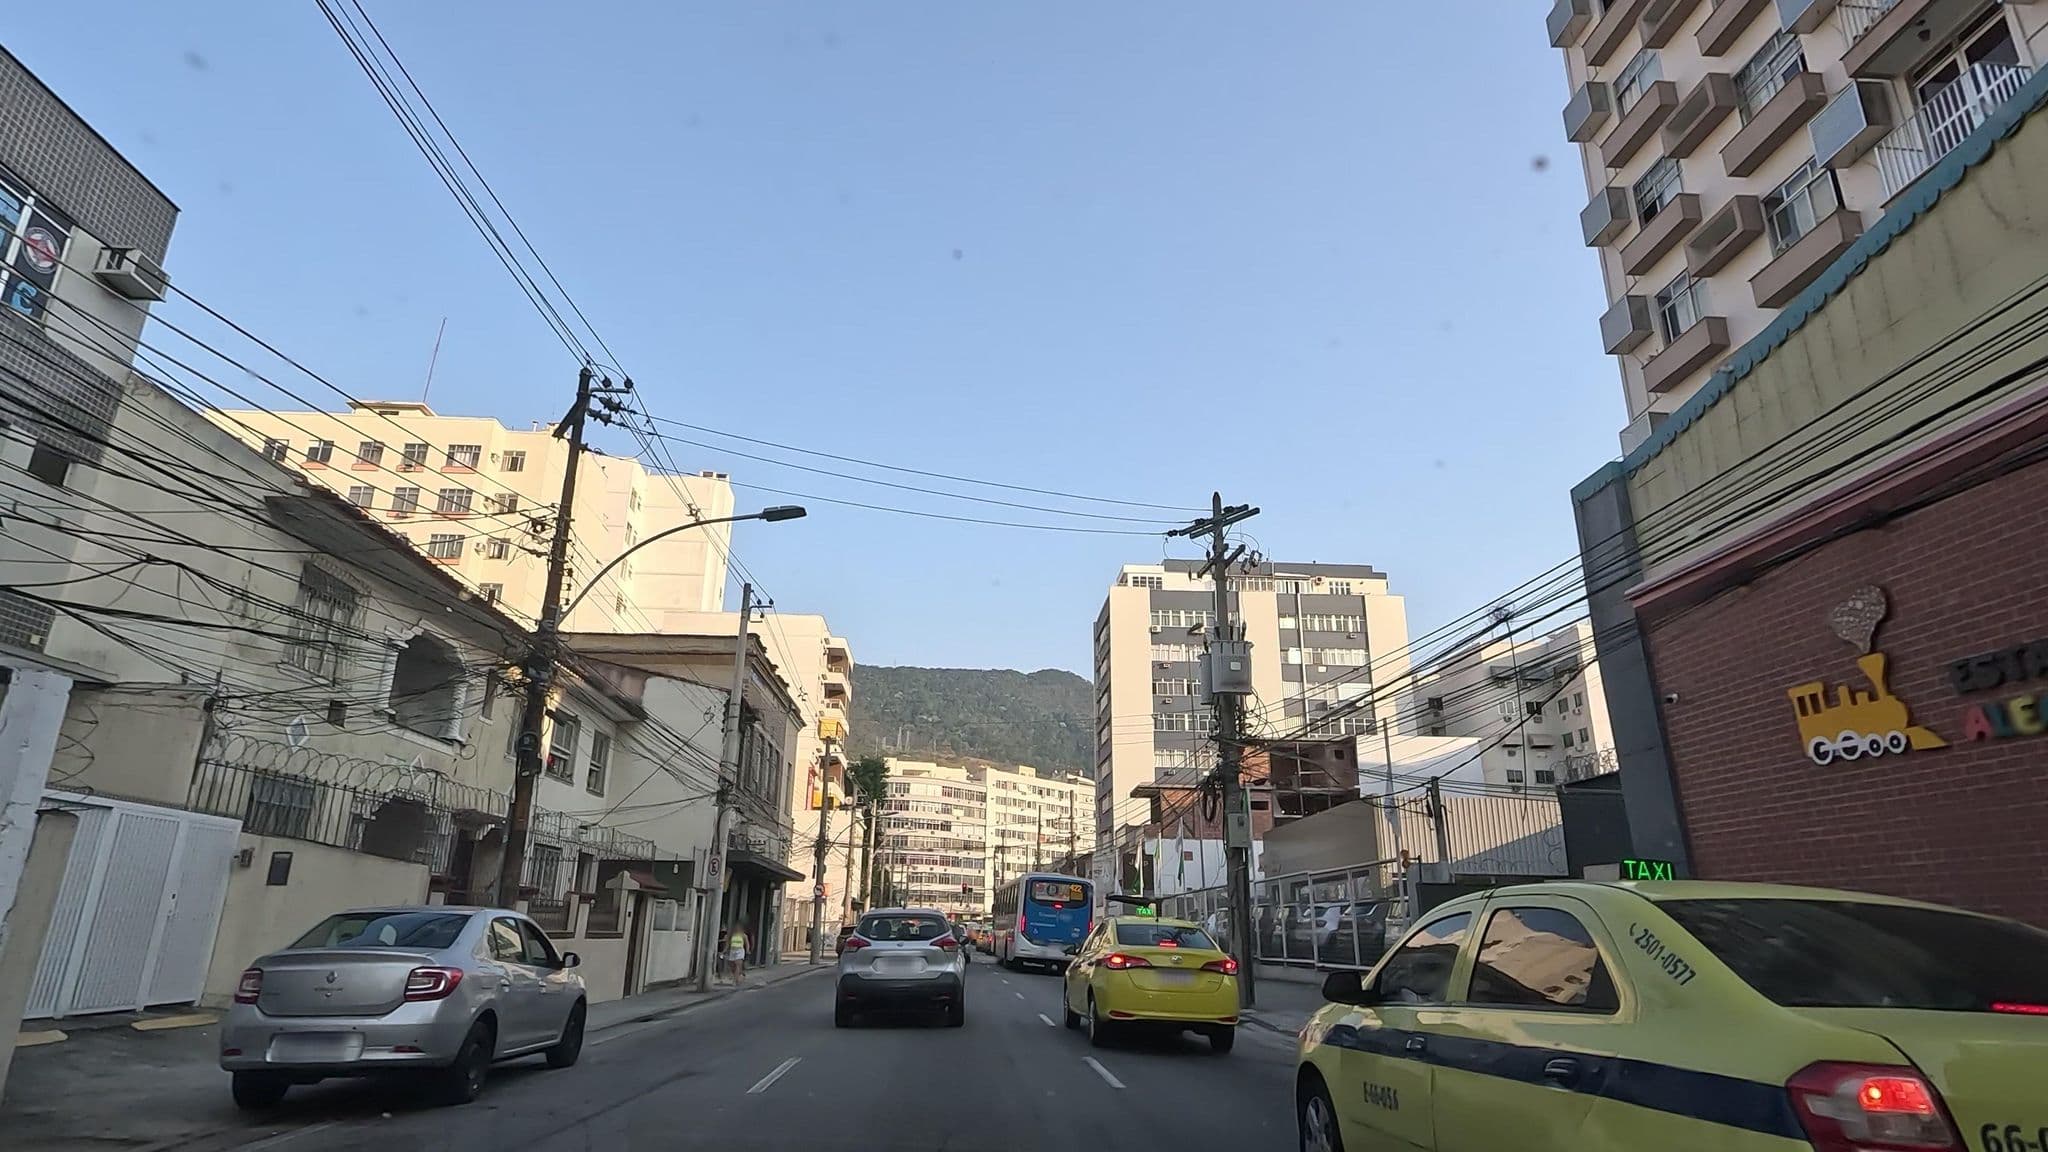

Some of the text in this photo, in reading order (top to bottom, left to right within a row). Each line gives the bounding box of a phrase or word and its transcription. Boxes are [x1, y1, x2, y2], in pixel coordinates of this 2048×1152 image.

[1624, 860, 1673, 881] TAXI
[1136, 907, 1154, 916] TAXI
[1634, 928, 1697, 986] 2501-0577
